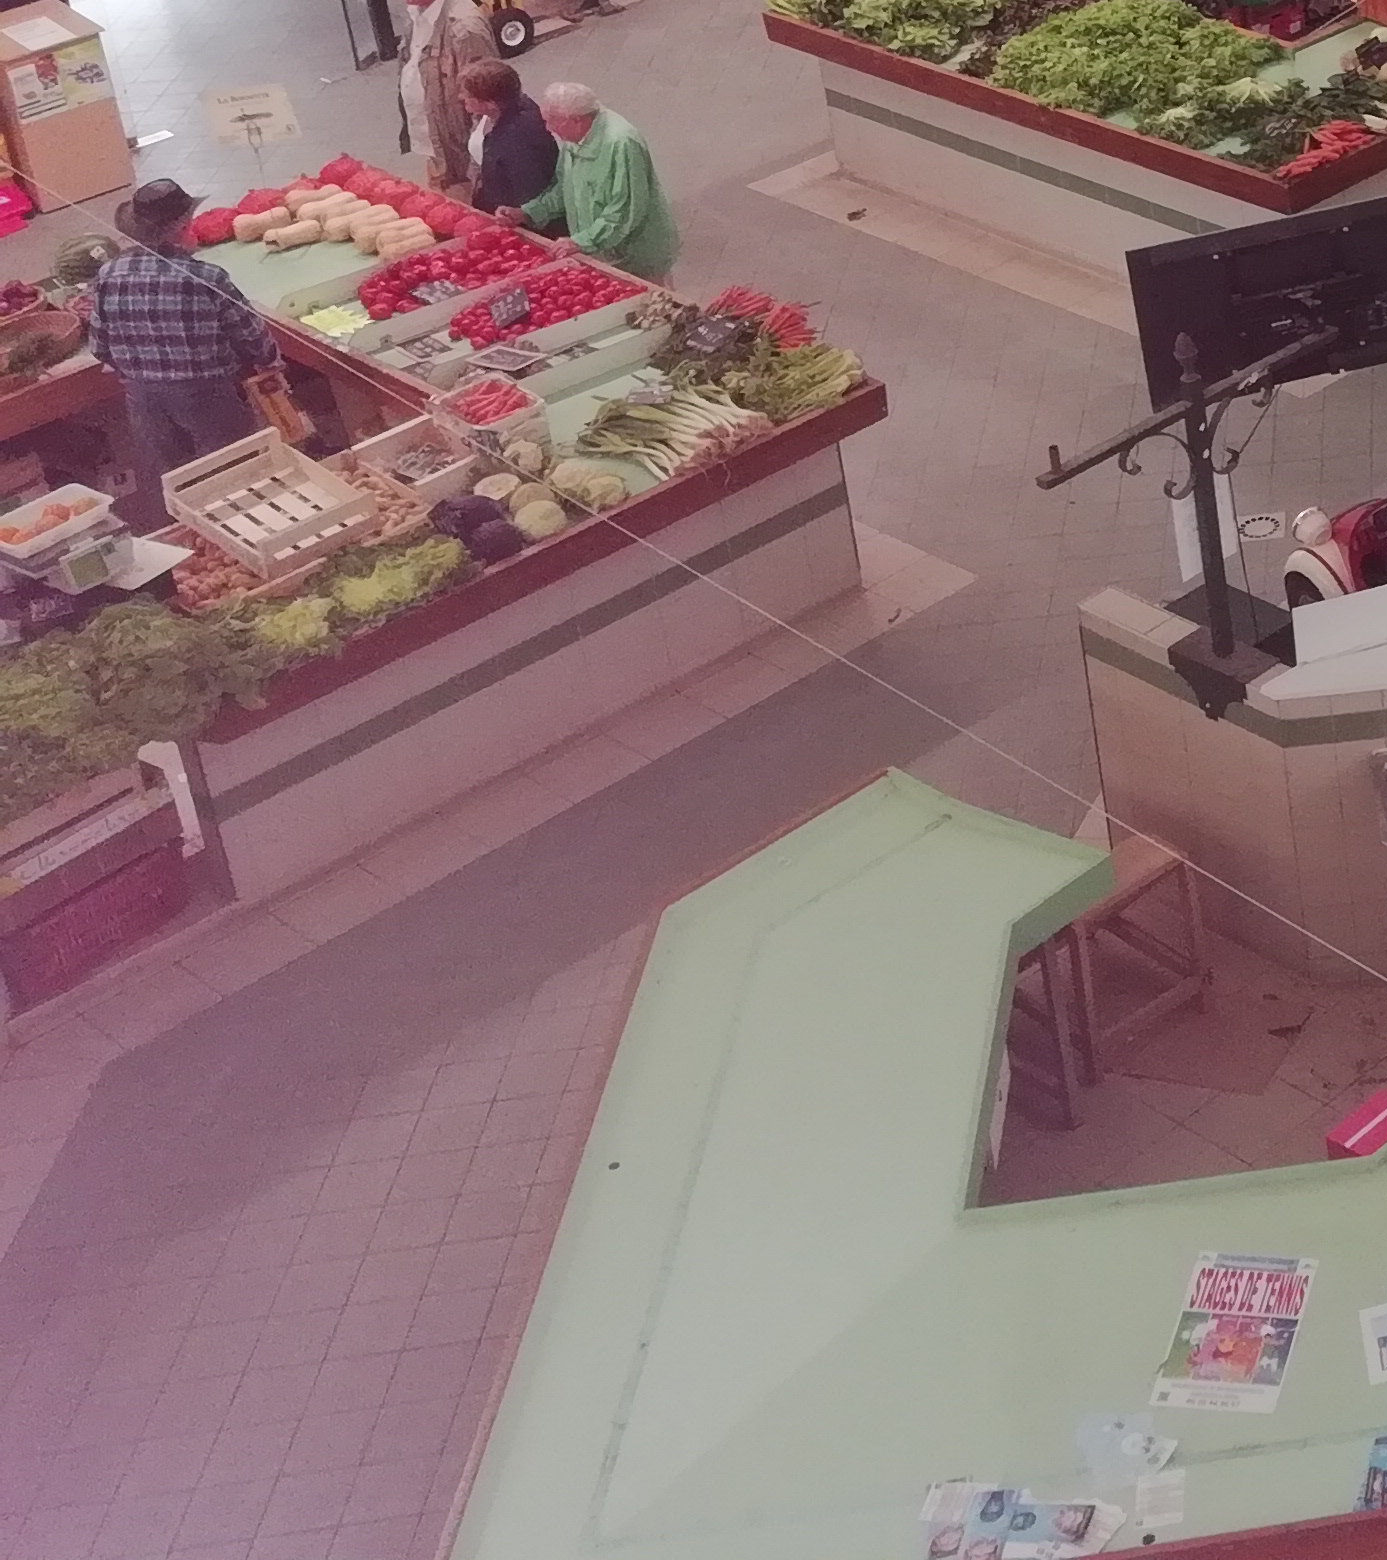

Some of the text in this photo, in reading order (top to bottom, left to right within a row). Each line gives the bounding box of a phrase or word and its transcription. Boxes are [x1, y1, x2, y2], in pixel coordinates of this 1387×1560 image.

[1188, 1266, 1311, 1318] STAGES DE TENNIS
